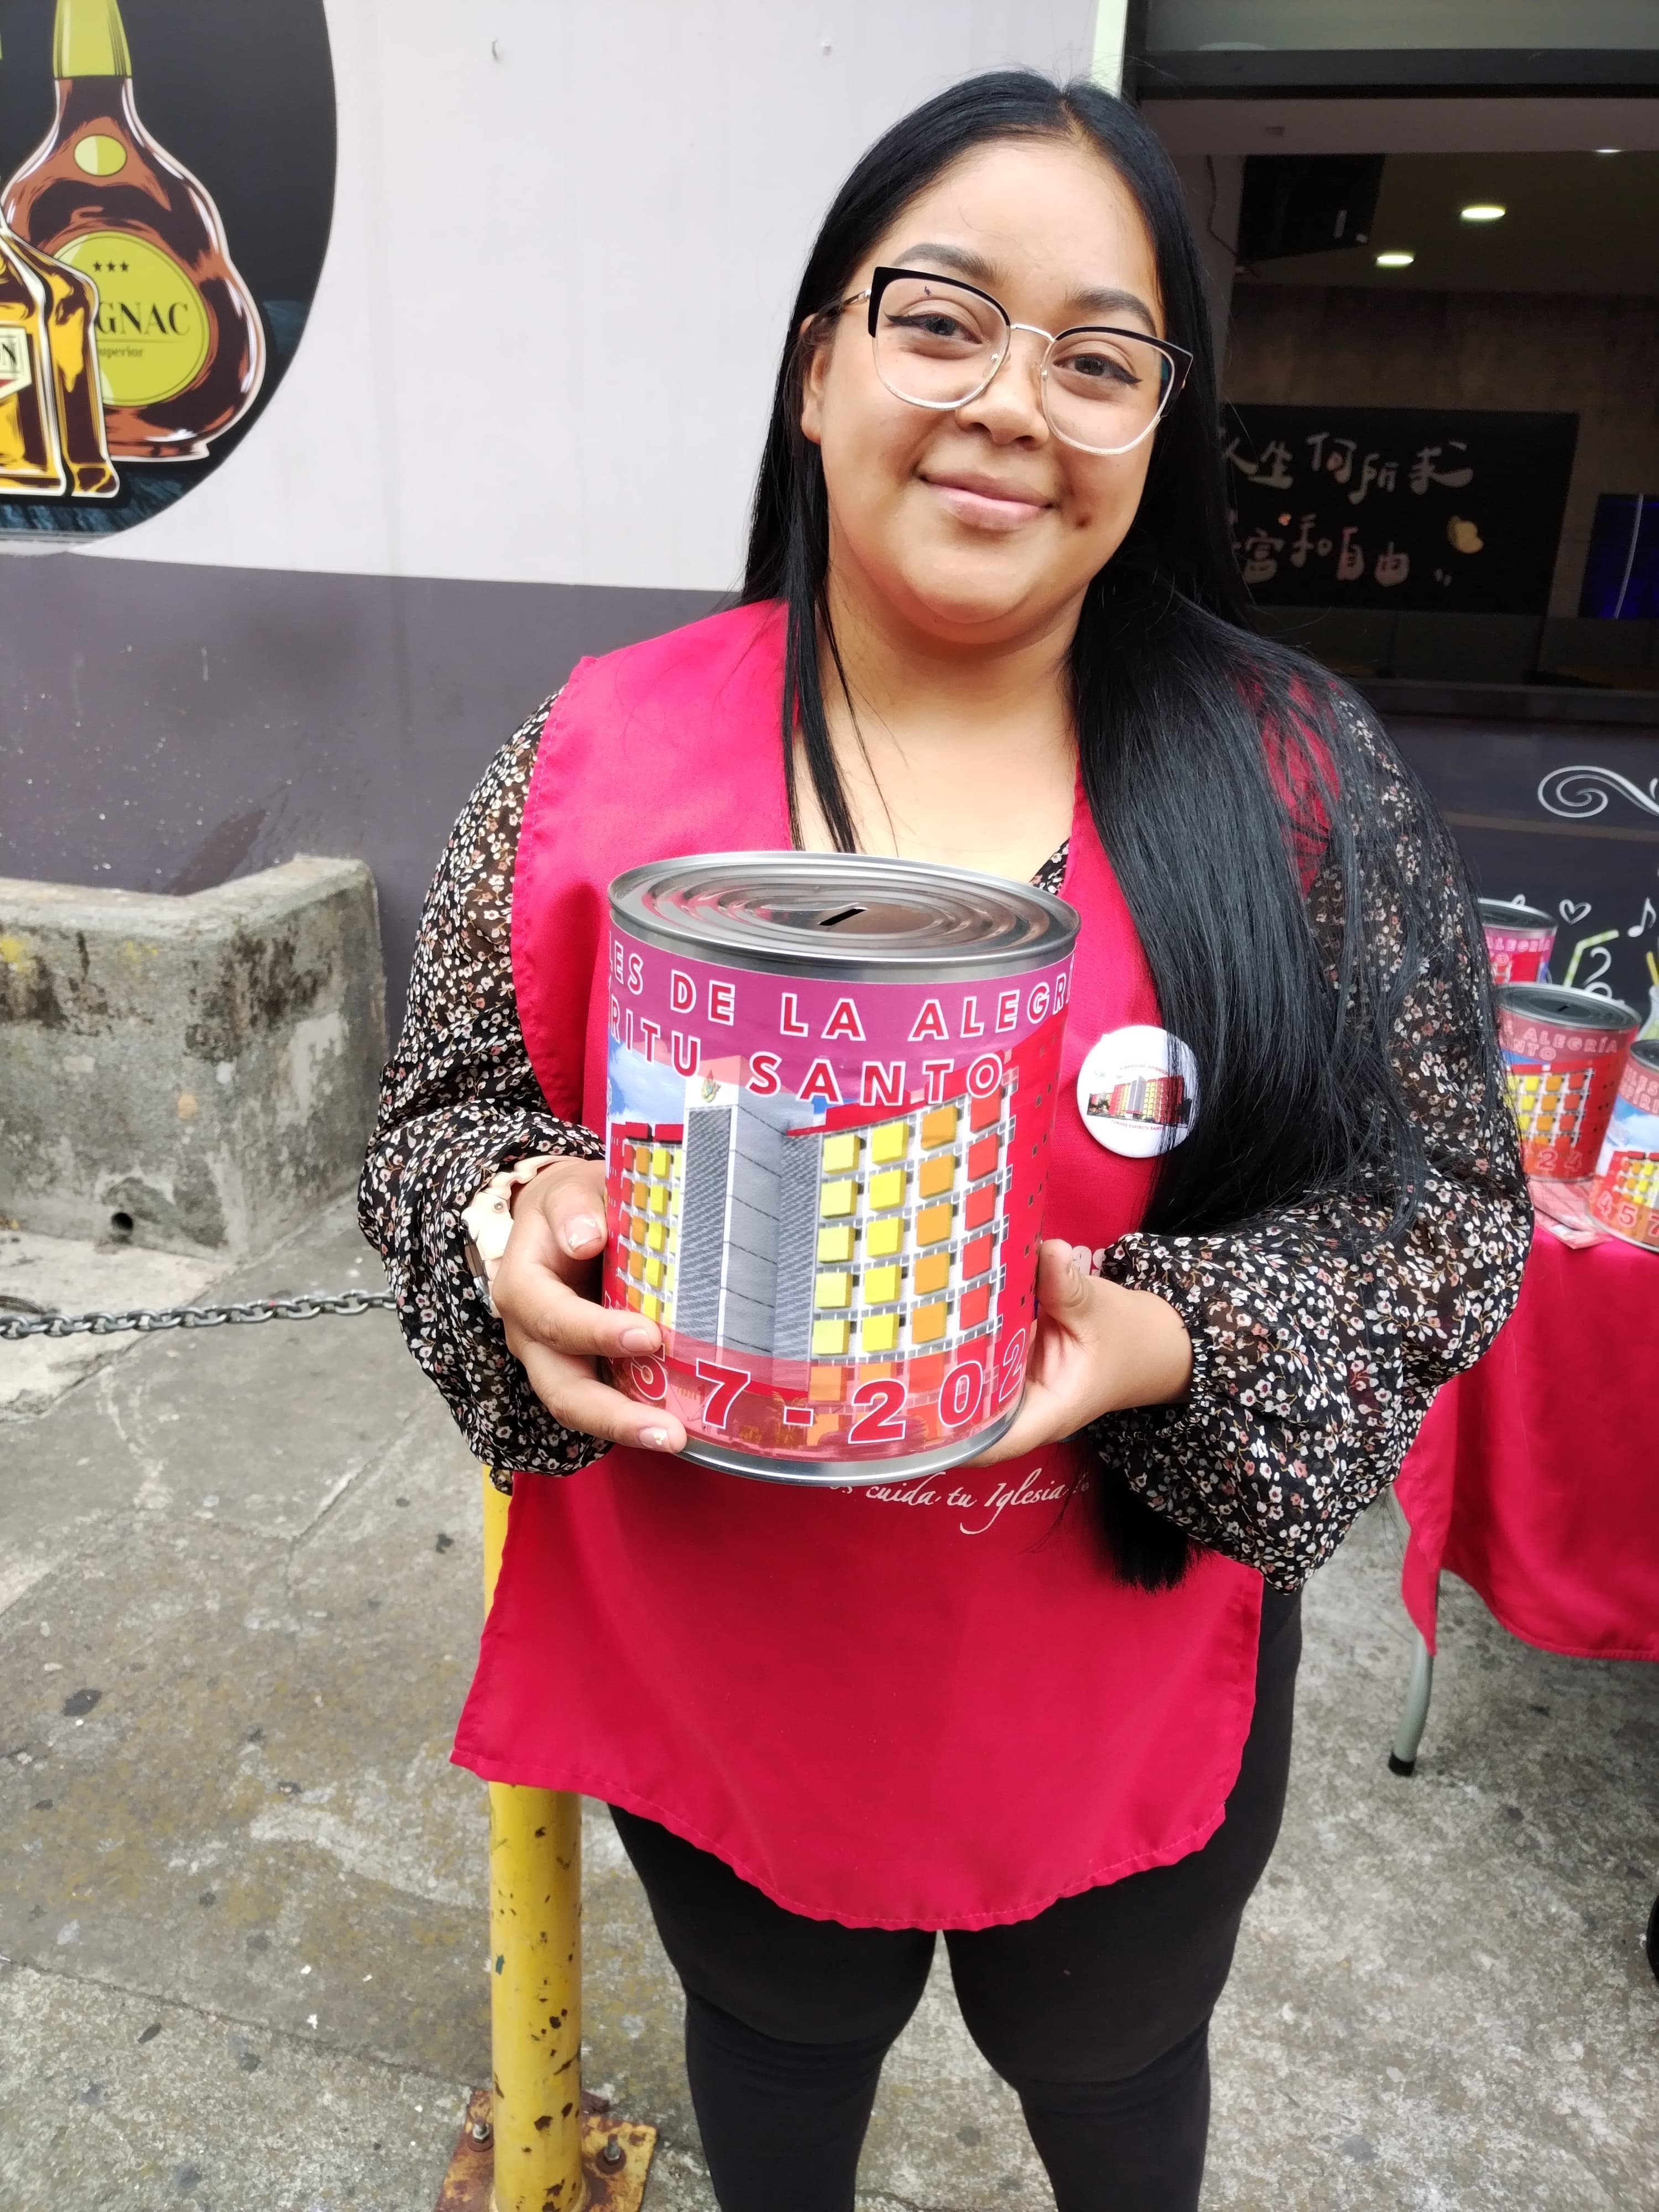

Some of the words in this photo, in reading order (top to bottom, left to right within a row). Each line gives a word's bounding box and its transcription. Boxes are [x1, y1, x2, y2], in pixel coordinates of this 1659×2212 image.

[95, 301, 191, 336] GNAC
[670, 969, 736, 1026] DE
[780, 993, 867, 1042] LA
[609, 993, 701, 1078] RITU
[747, 1052, 1004, 1107] SANTO
[1522, 1027, 1618, 1053] ALEGRÍA
[1537, 1149, 1583, 1172] 24
[866, 1472, 946, 1506] cuida
[947, 1487, 977, 1507] tu
[960, 1468, 1068, 1534] Iglesia
